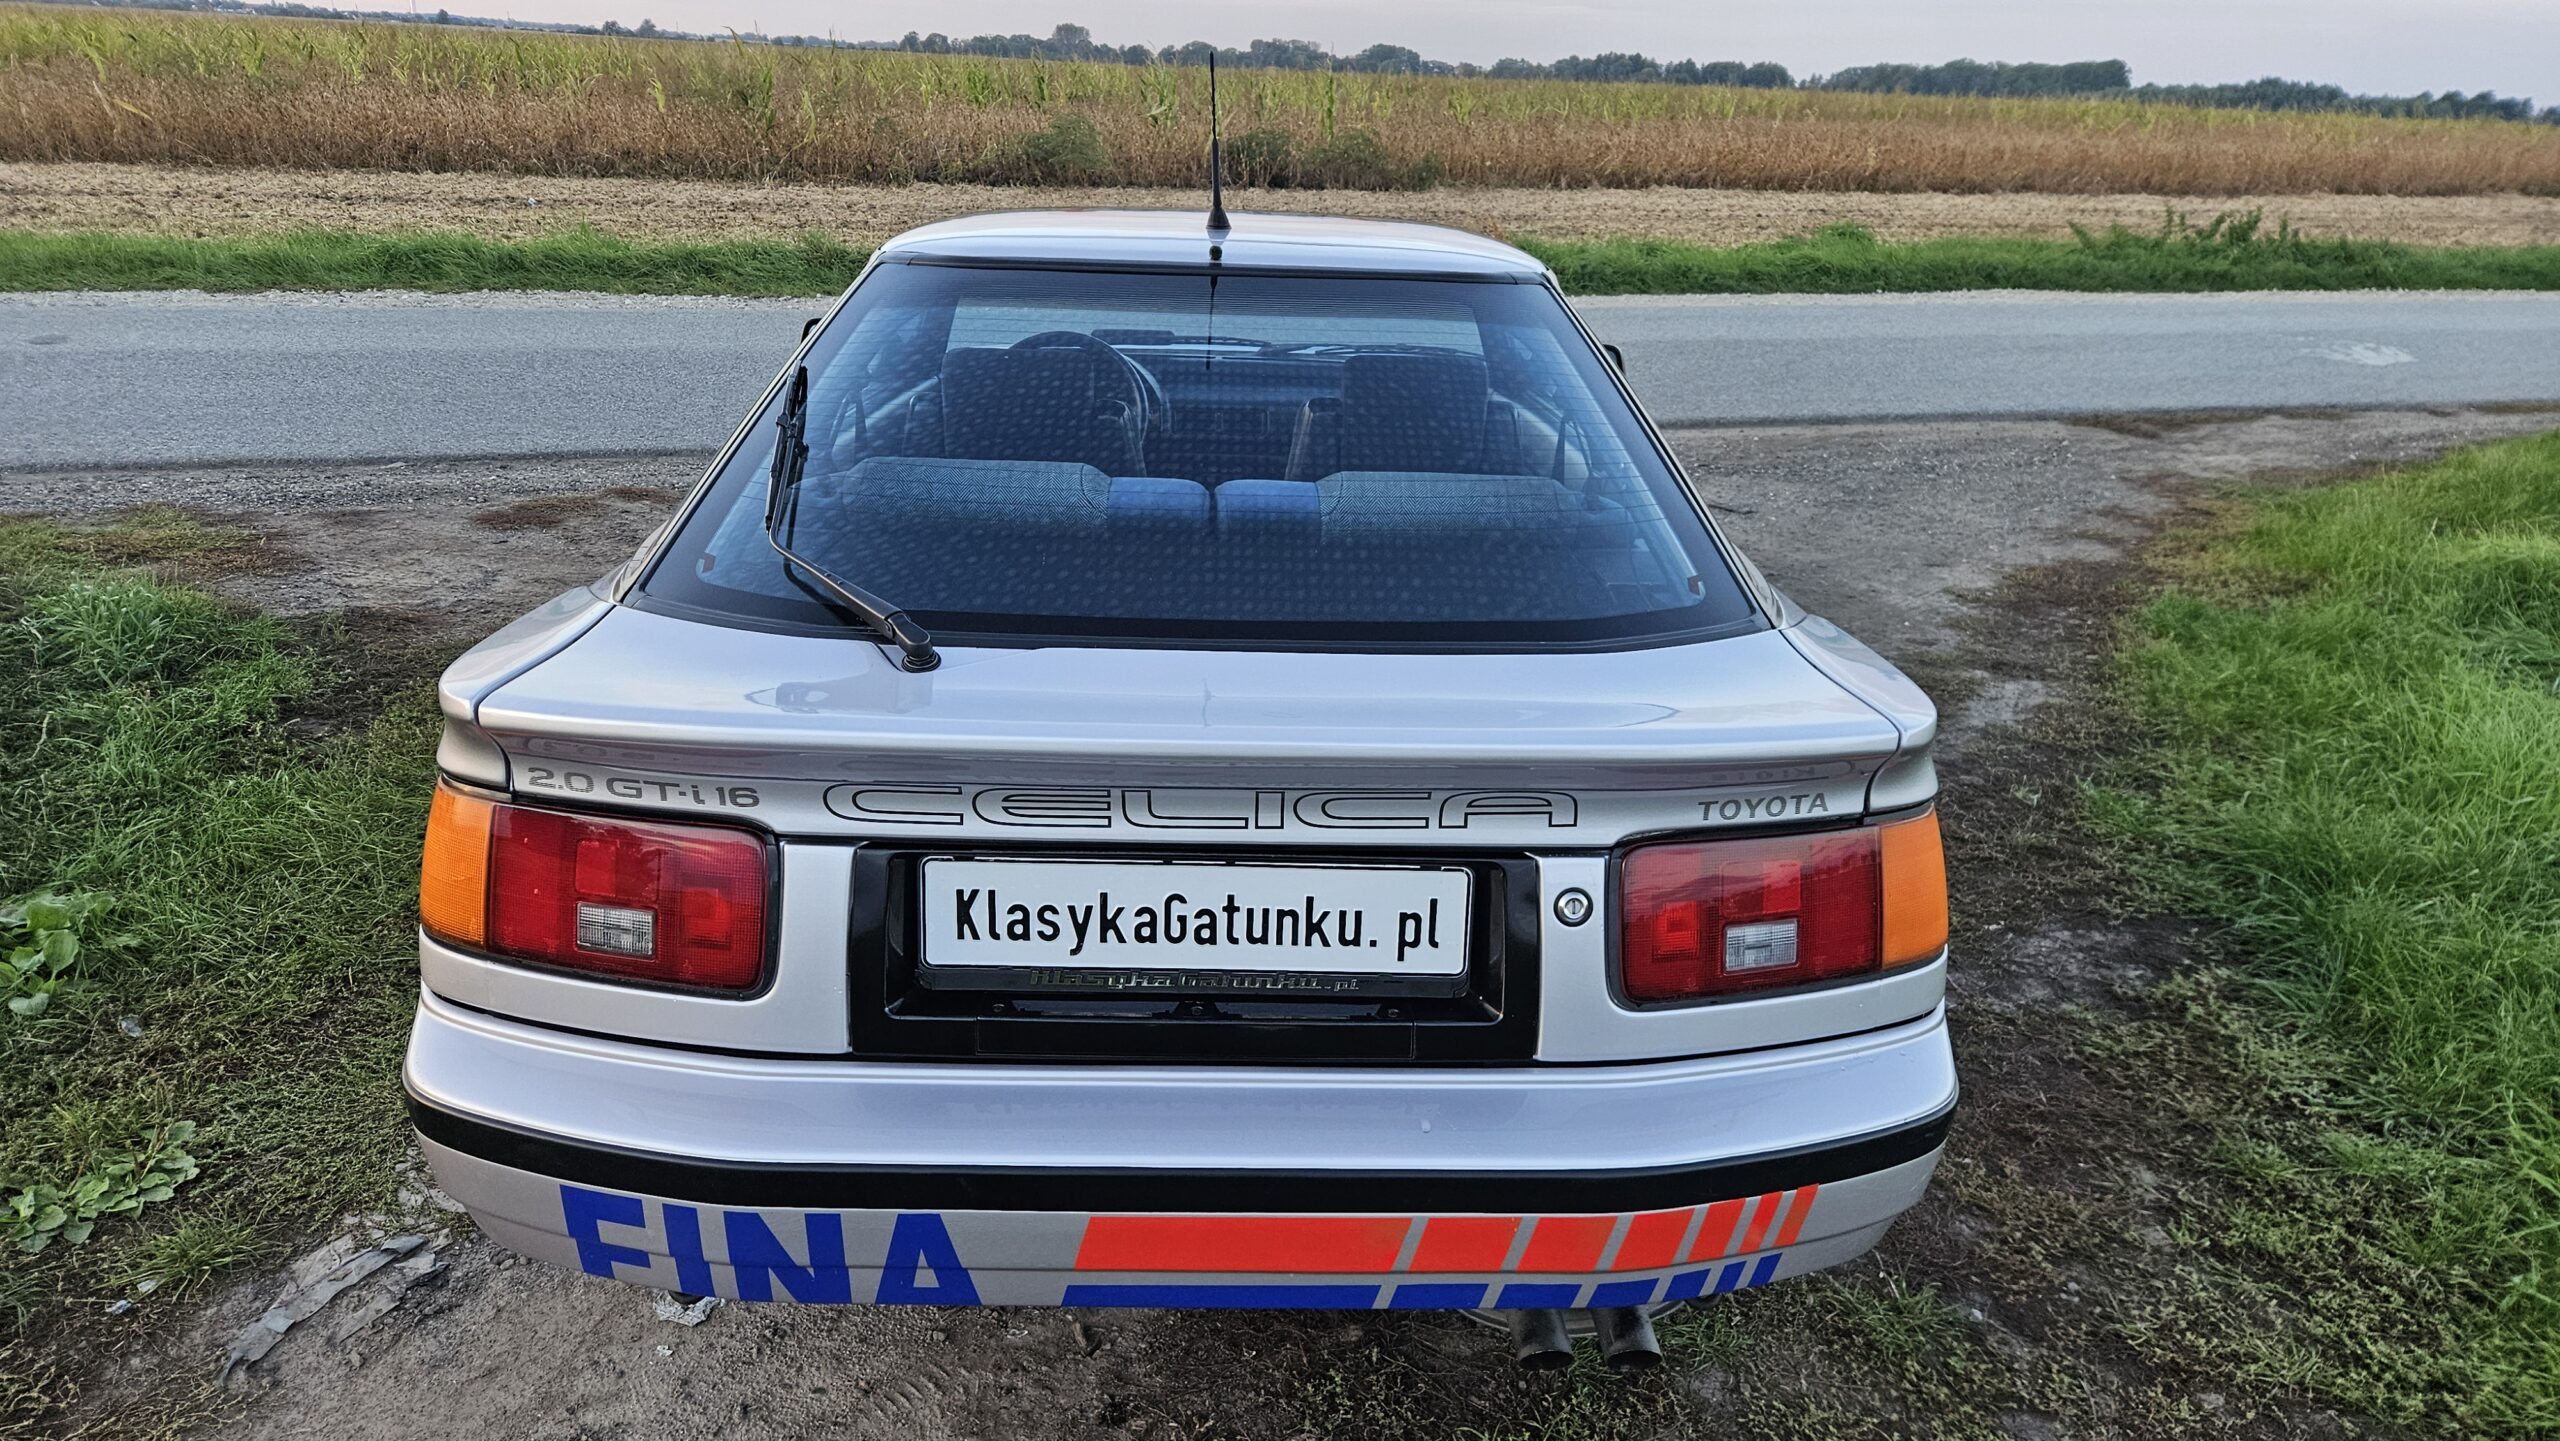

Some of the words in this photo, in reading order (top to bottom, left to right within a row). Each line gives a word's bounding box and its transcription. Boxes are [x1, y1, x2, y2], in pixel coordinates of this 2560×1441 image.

[528, 767, 595, 794] 2.0
[715, 786, 761, 808] 16
[822, 784, 1579, 830] CELICA
[1697, 792, 1829, 821] TOYOTA
[559, 1184, 983, 1308] FINA
